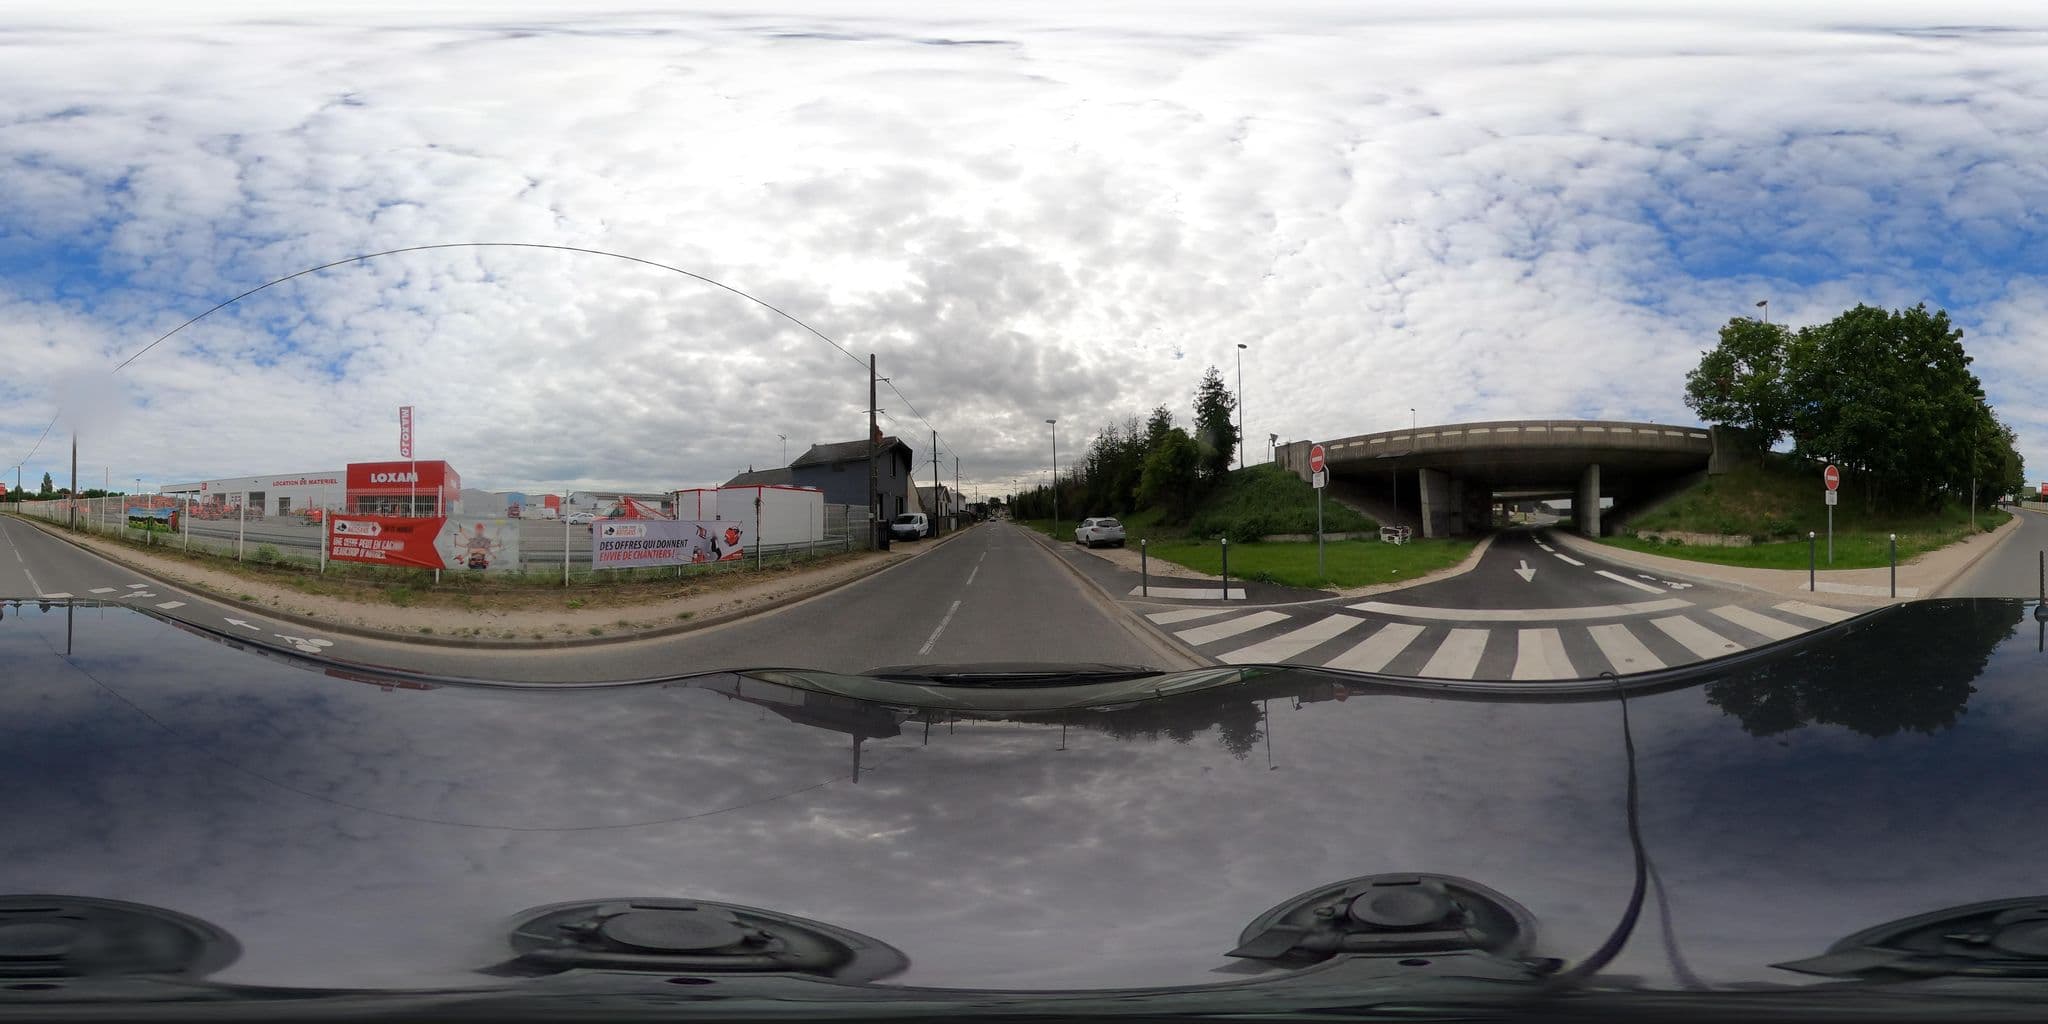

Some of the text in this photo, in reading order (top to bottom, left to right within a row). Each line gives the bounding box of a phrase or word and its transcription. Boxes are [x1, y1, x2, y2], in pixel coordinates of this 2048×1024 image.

[371, 472, 418, 483] LOXAM
[600, 540, 688, 551] DES OFFRES QUI DONNENT
[600, 551, 621, 561] ENVIE
[622, 551, 632, 560] DE
[633, 550, 671, 559] CHANTIERS
